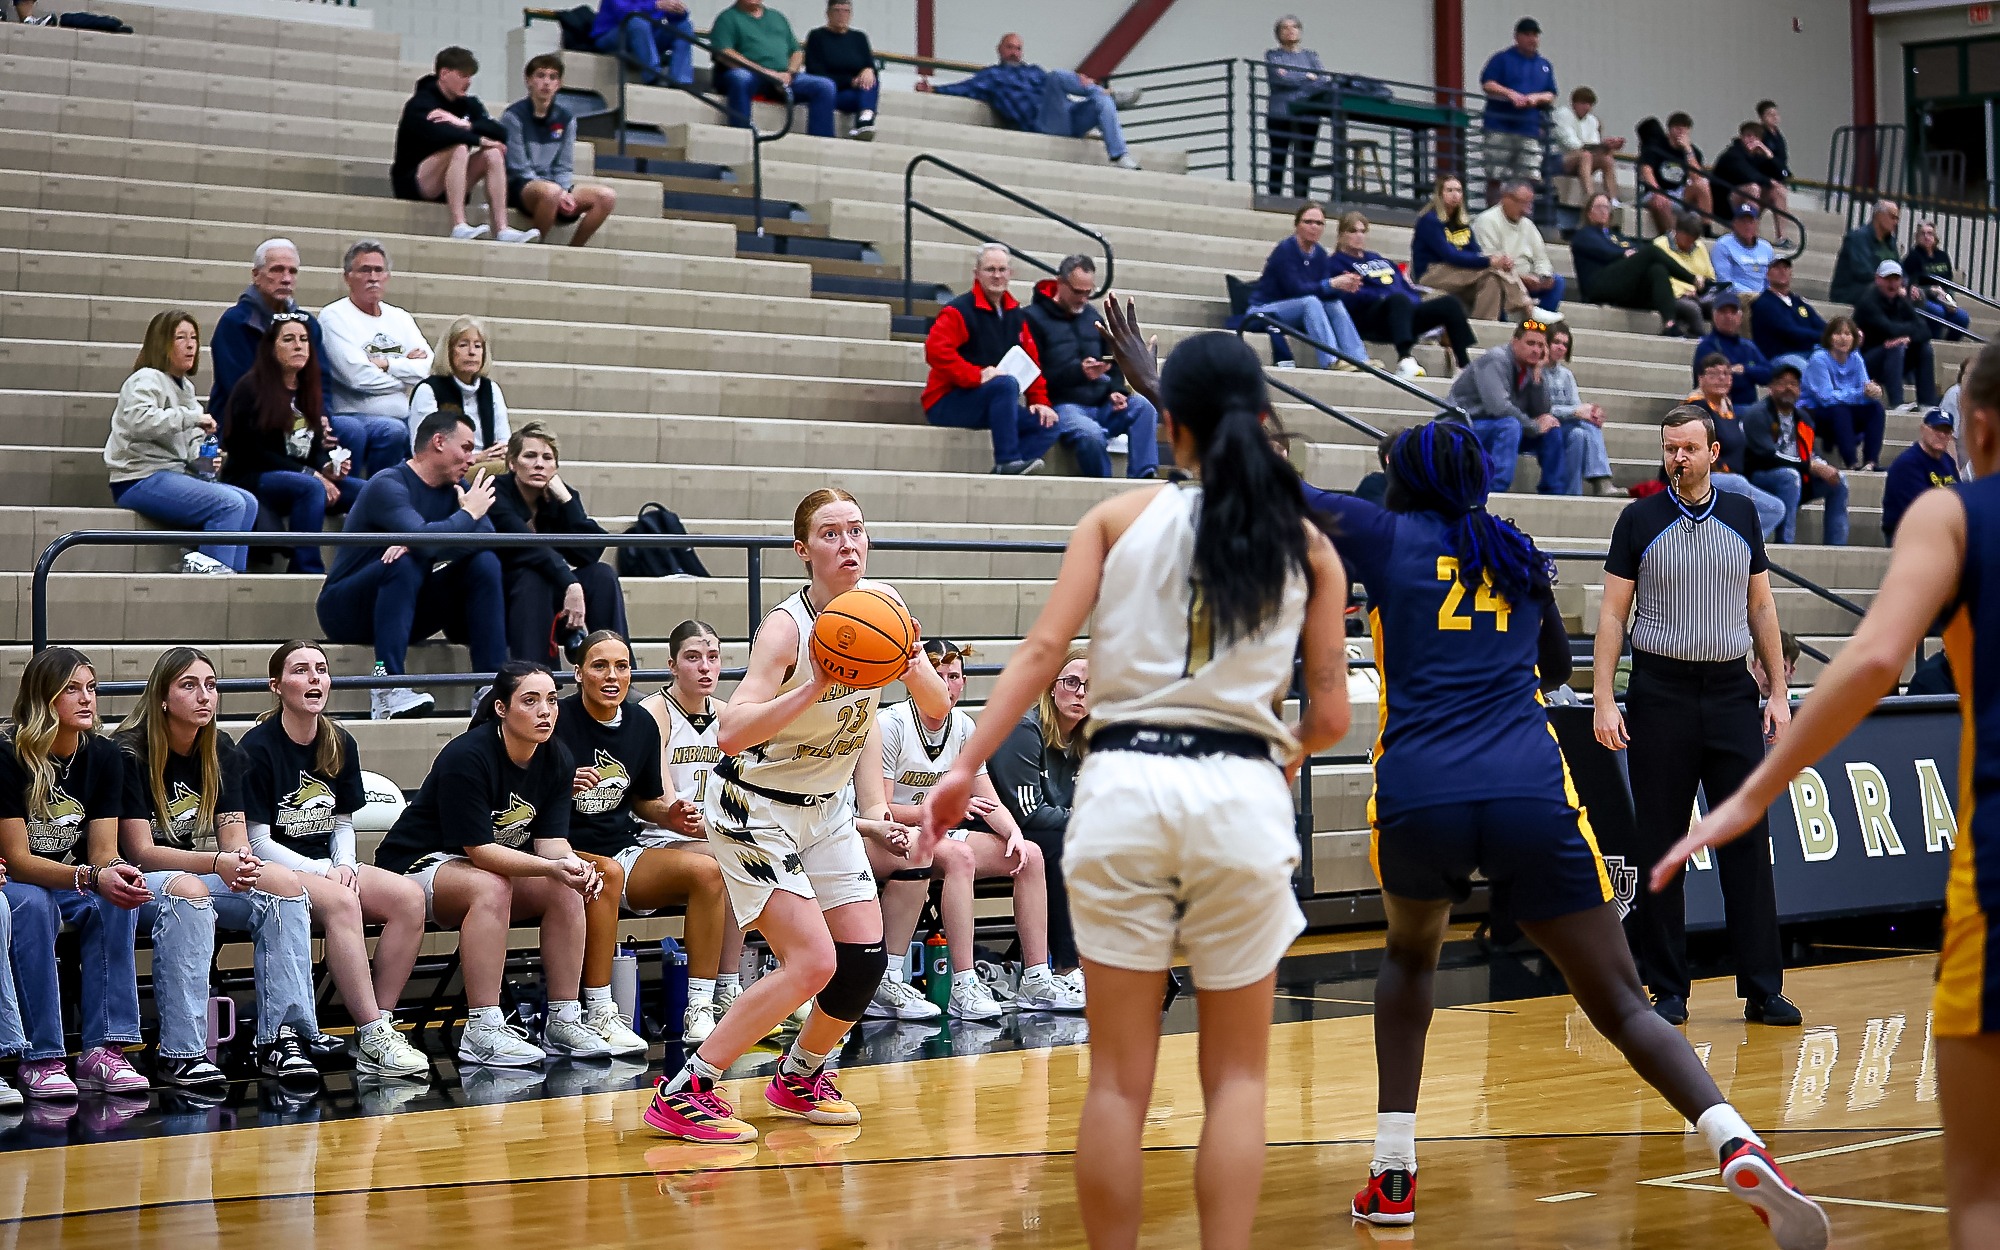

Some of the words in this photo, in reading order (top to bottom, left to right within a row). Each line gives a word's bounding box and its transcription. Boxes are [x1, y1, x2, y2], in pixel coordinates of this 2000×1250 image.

[1437, 556, 1513, 632] 24
[823, 657, 859, 680] EVO
[837, 697, 870, 739] 23
[933, 957, 948, 975] G
